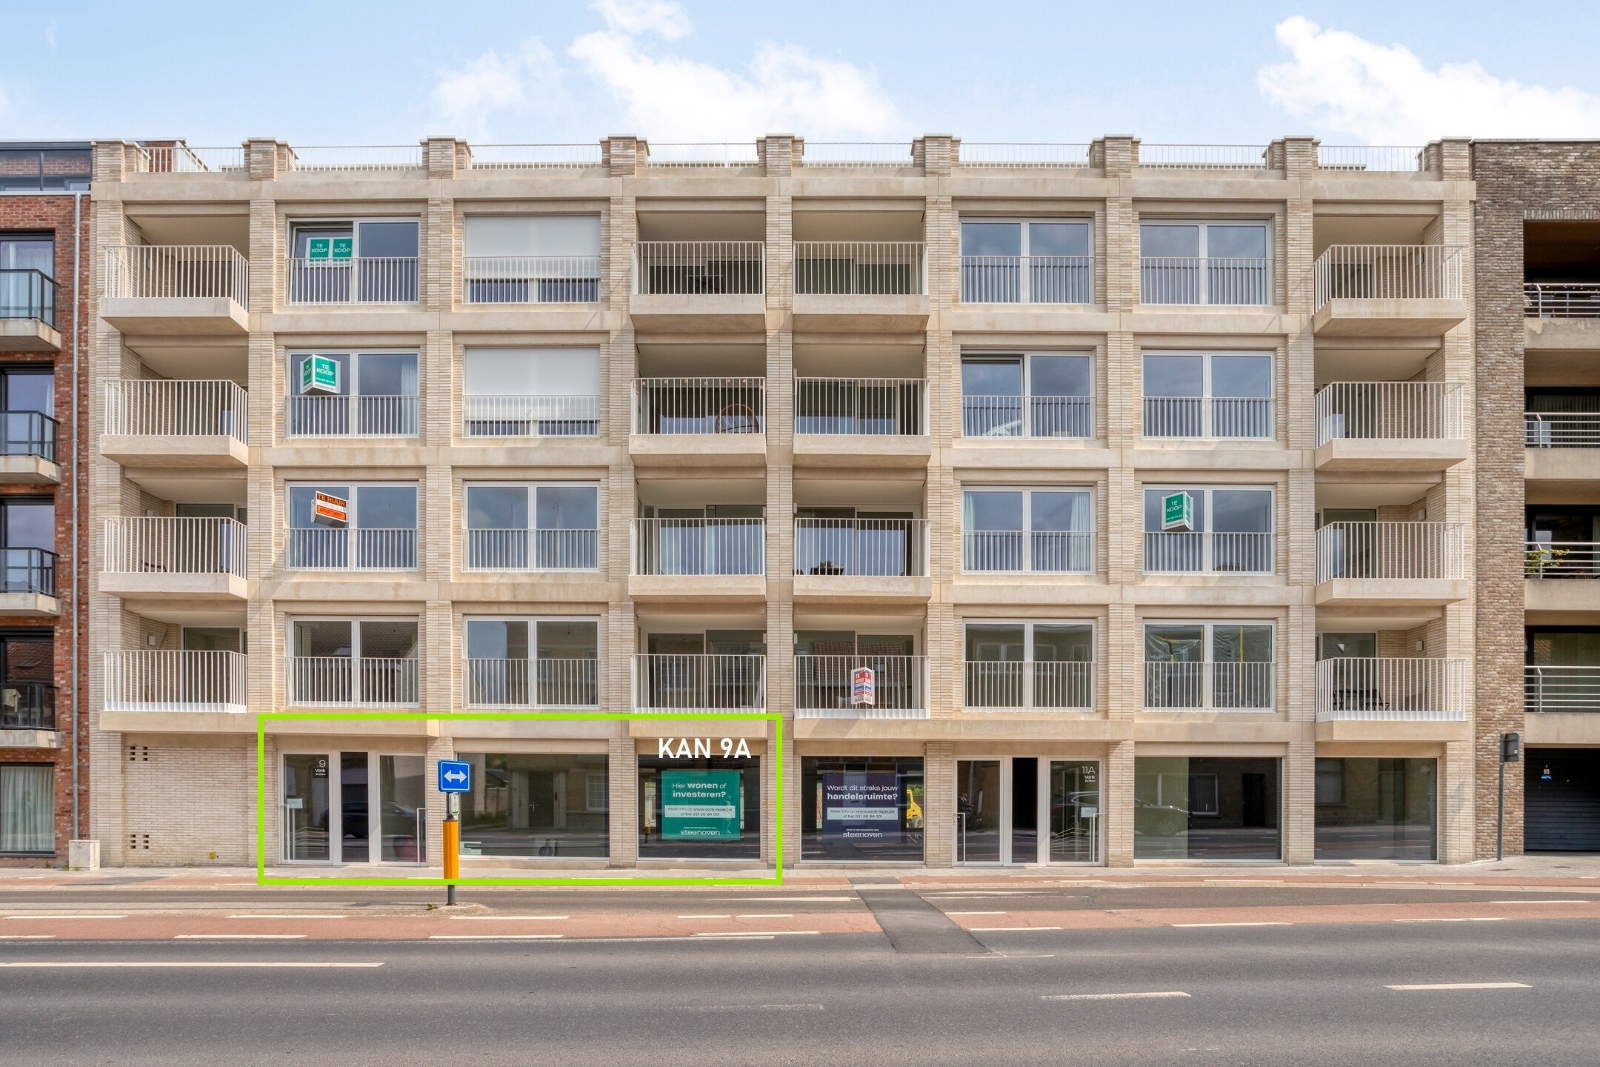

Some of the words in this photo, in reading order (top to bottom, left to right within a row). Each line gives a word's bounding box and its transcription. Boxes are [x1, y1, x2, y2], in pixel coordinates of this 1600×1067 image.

[316, 368, 335, 376] KOOP
[327, 496, 346, 507] HUUR
[1166, 504, 1182, 512] KOOP
[318, 760, 326, 768] 9
[1082, 766, 1096, 774] 11A
[672, 790, 727, 798] investeren?
